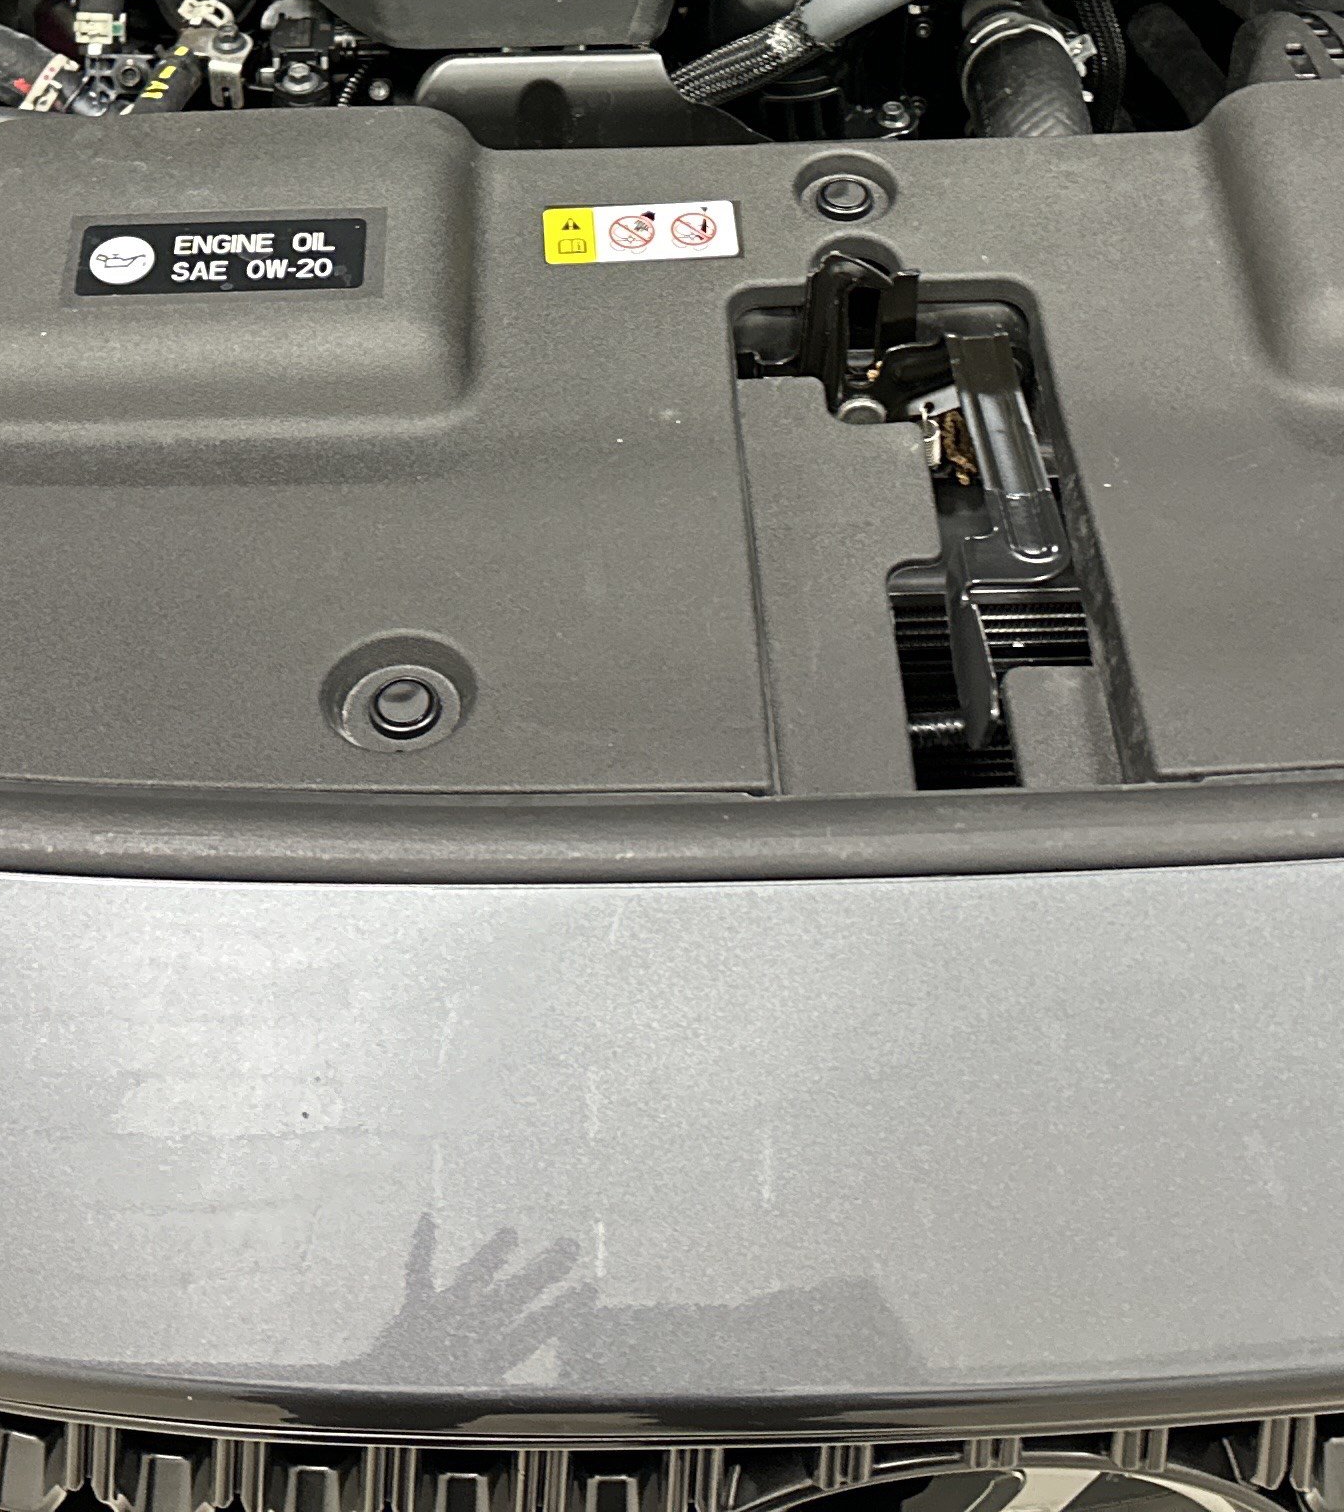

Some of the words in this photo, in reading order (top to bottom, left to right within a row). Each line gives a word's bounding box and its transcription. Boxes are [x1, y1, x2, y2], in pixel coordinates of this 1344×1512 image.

[173, 233, 275, 255] ENGINE
[292, 231, 336, 253] OIL
[171, 260, 229, 282] SAE
[246, 257, 333, 280] 0W-20
